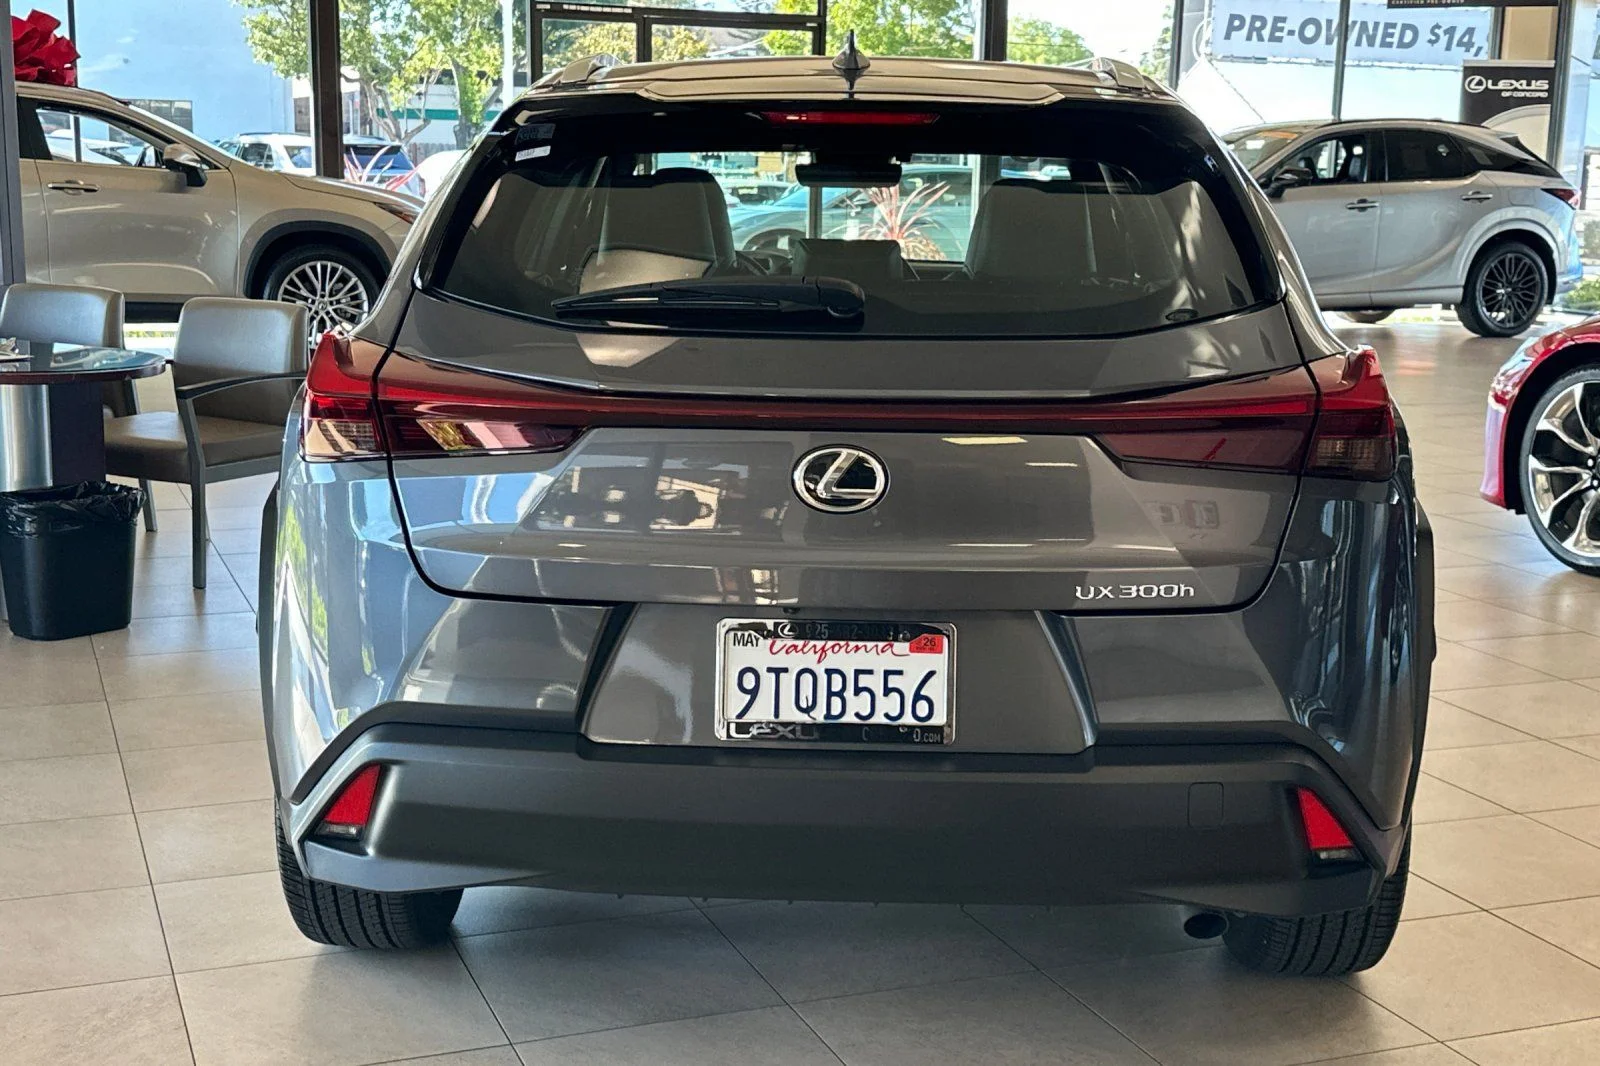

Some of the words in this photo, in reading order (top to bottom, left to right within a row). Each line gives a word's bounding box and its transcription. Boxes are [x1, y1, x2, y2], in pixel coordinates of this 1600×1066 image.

[1224, 13, 1419, 50] PRE-OWNED
[1427, 22, 1488, 57] $14,
[1487, 80, 1549, 90] LEXUS
[1075, 585, 1115, 600] UX
[1119, 583, 1195, 599] 300h
[733, 631, 760, 648] MAY
[769, 639, 910, 665] California
[923, 637, 936, 647] 26
[735, 667, 937, 723] 9TQB556
